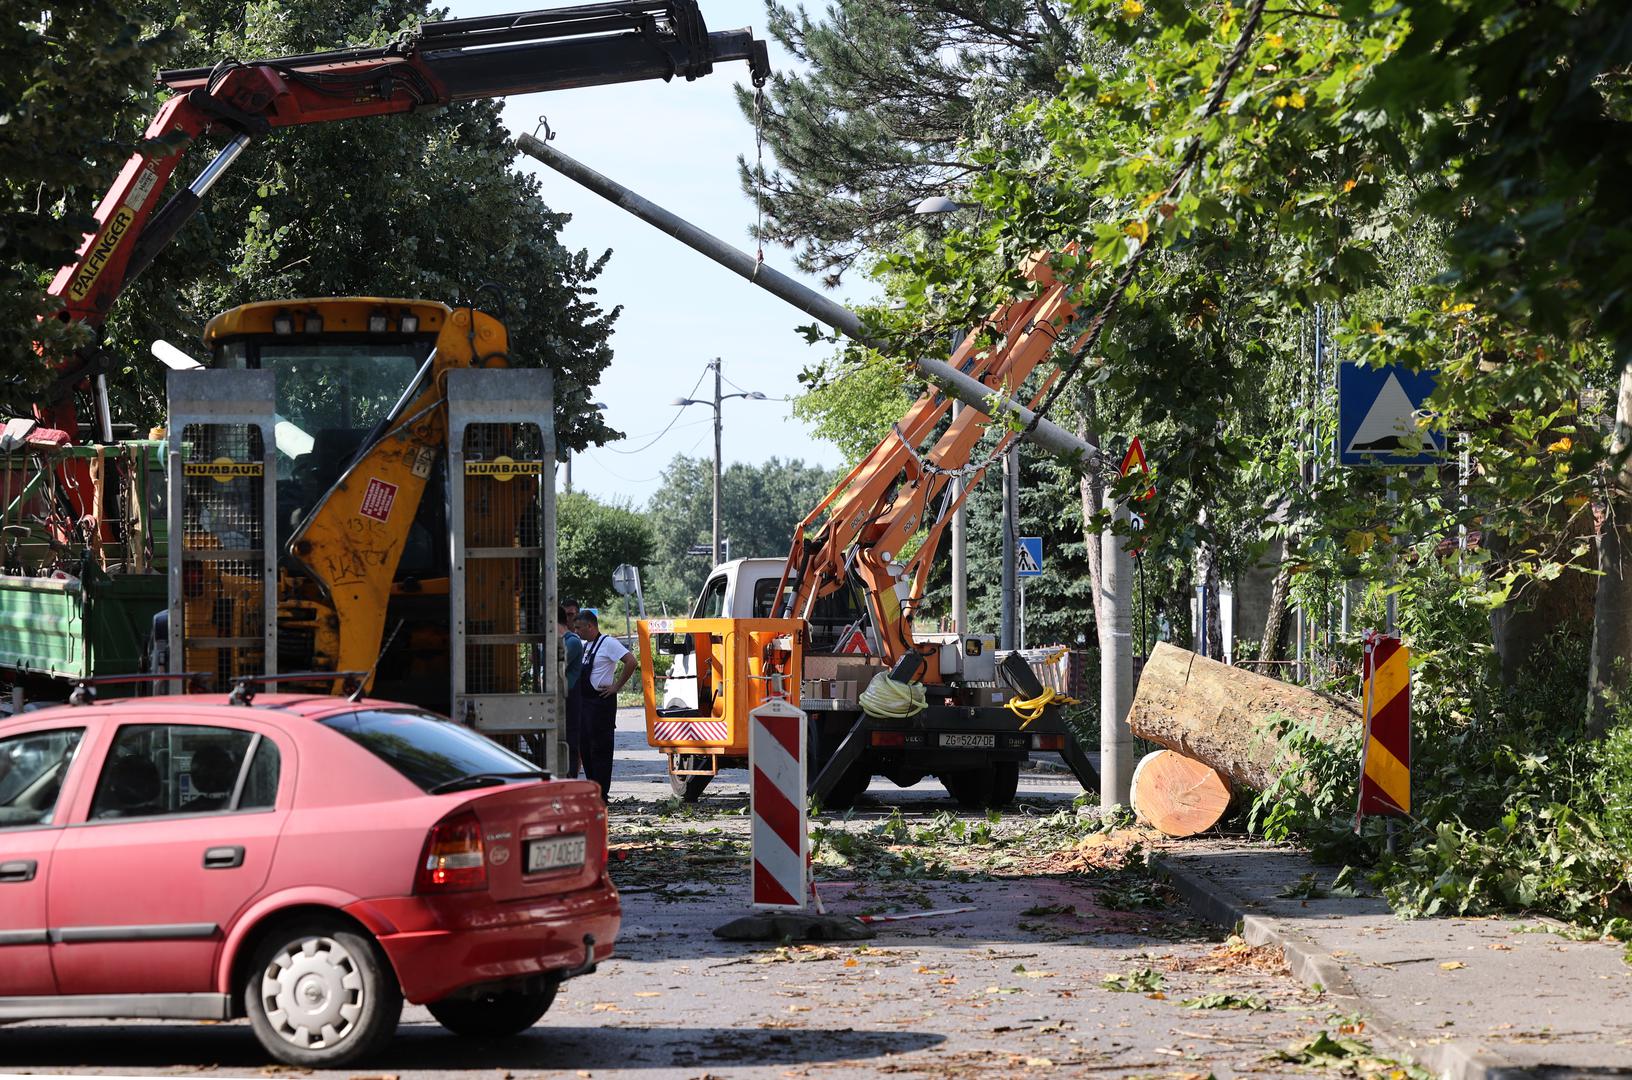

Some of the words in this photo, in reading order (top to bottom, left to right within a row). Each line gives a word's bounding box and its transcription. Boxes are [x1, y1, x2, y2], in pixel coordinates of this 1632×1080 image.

[72, 212, 131, 296] PALFINGER
[187, 465, 260, 474] HUMBAUR
[468, 464, 540, 473] HUMBAUR
[945, 735, 956, 745] ZG
